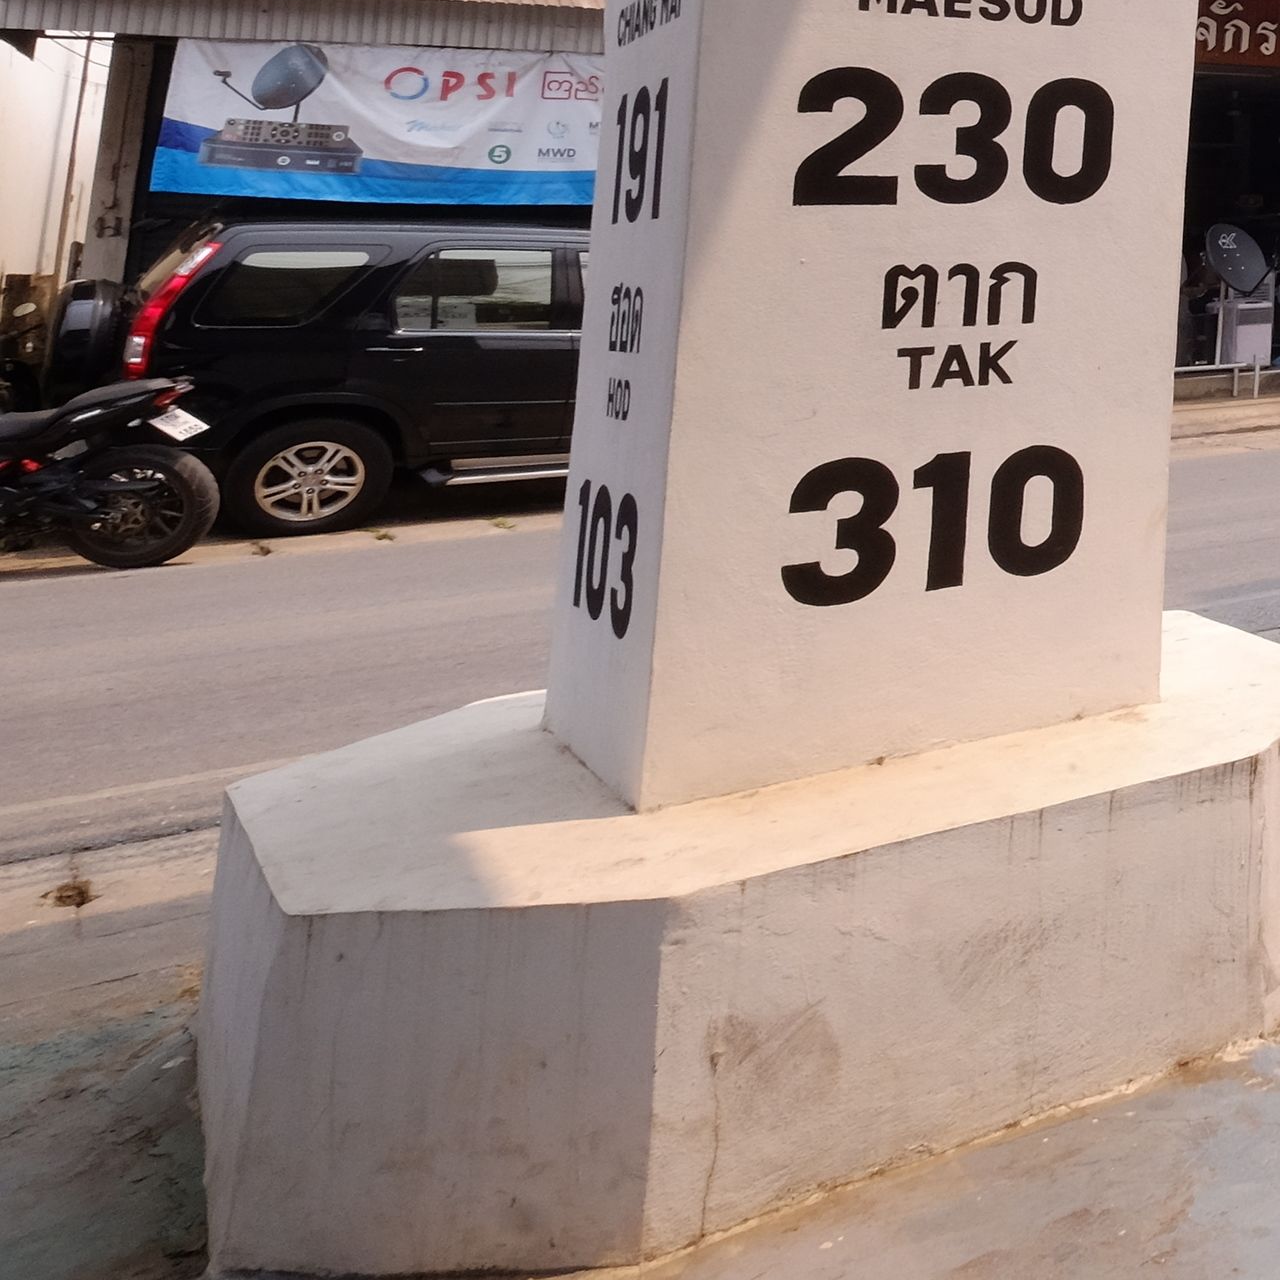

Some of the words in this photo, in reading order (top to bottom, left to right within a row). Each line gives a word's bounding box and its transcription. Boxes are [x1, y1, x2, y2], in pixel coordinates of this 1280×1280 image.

[537, 148, 577, 158] MWD
[611, 77, 670, 225] 191
[792, 66, 1115, 206] 230
[608, 282, 644, 354] ฮอด
[881, 260, 1038, 330] ตาก
[606, 376, 631, 421] HOD
[896, 339, 1019, 391] TAK
[572, 478, 639, 640] 103
[780, 444, 1084, 607] 310
